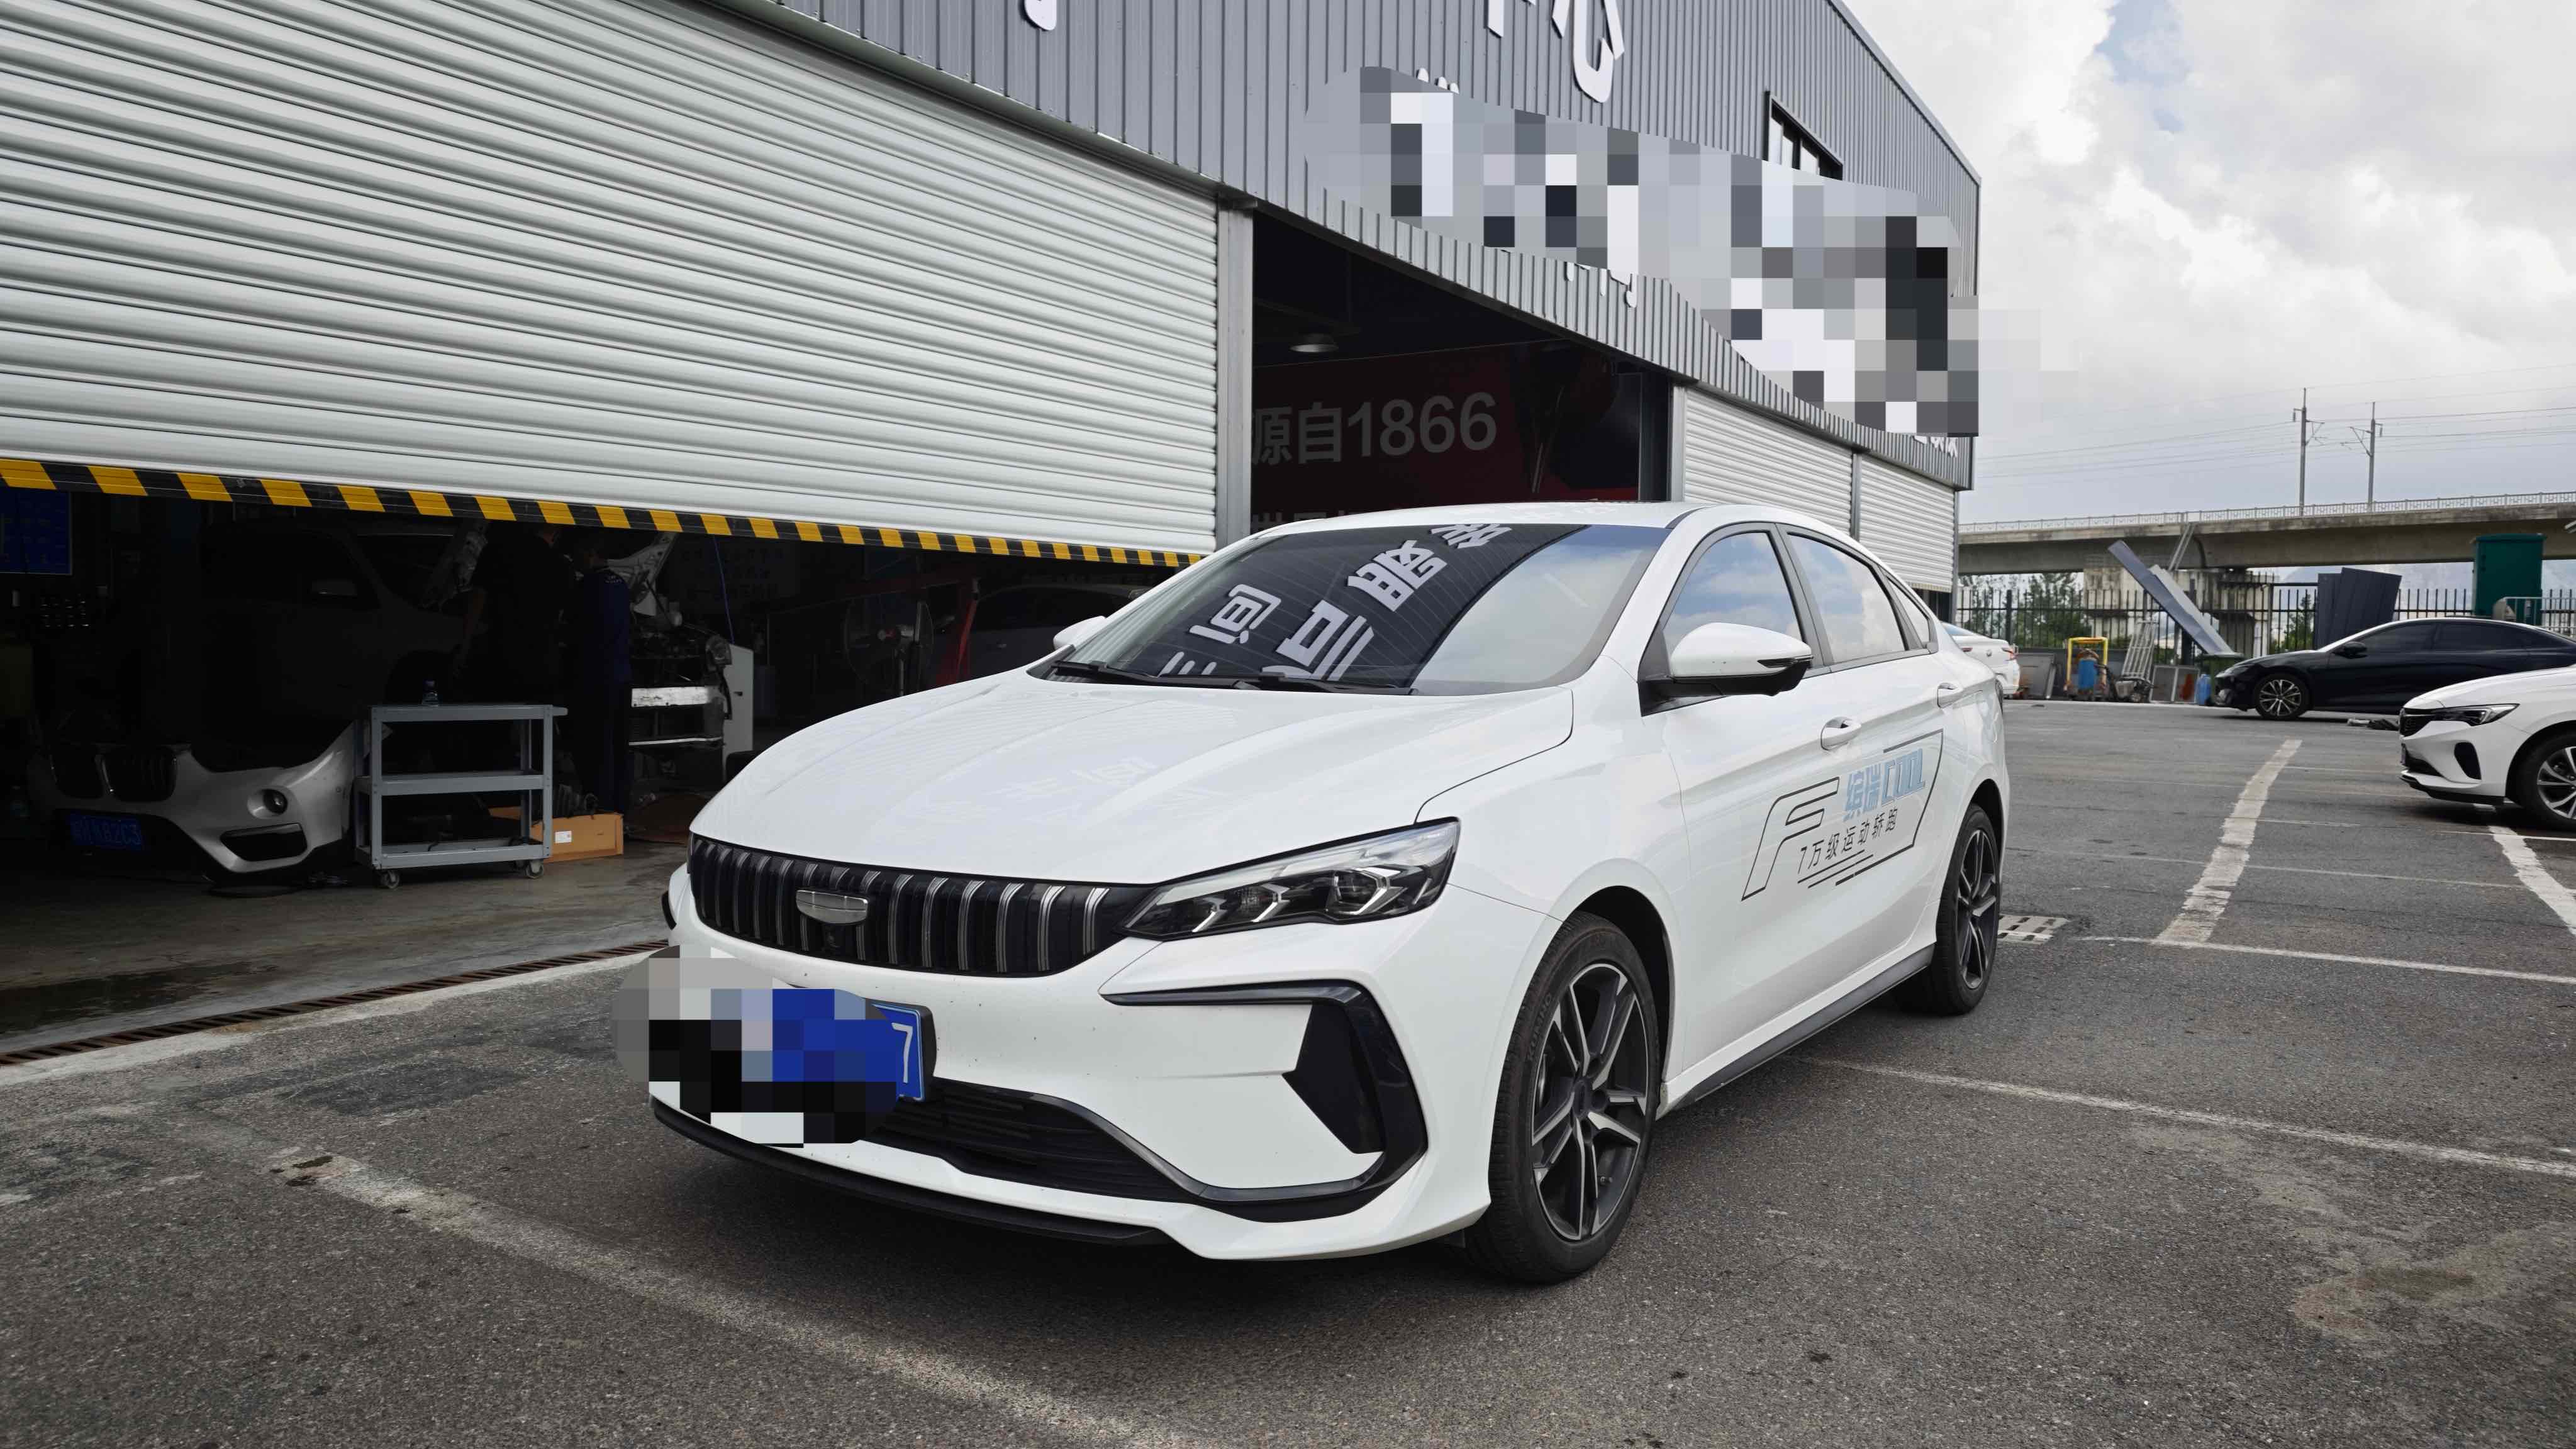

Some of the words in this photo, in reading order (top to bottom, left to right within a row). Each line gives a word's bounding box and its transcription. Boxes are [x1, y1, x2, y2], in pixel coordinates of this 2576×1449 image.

[1797, 806, 1899, 875] 7万级运动轿跑
